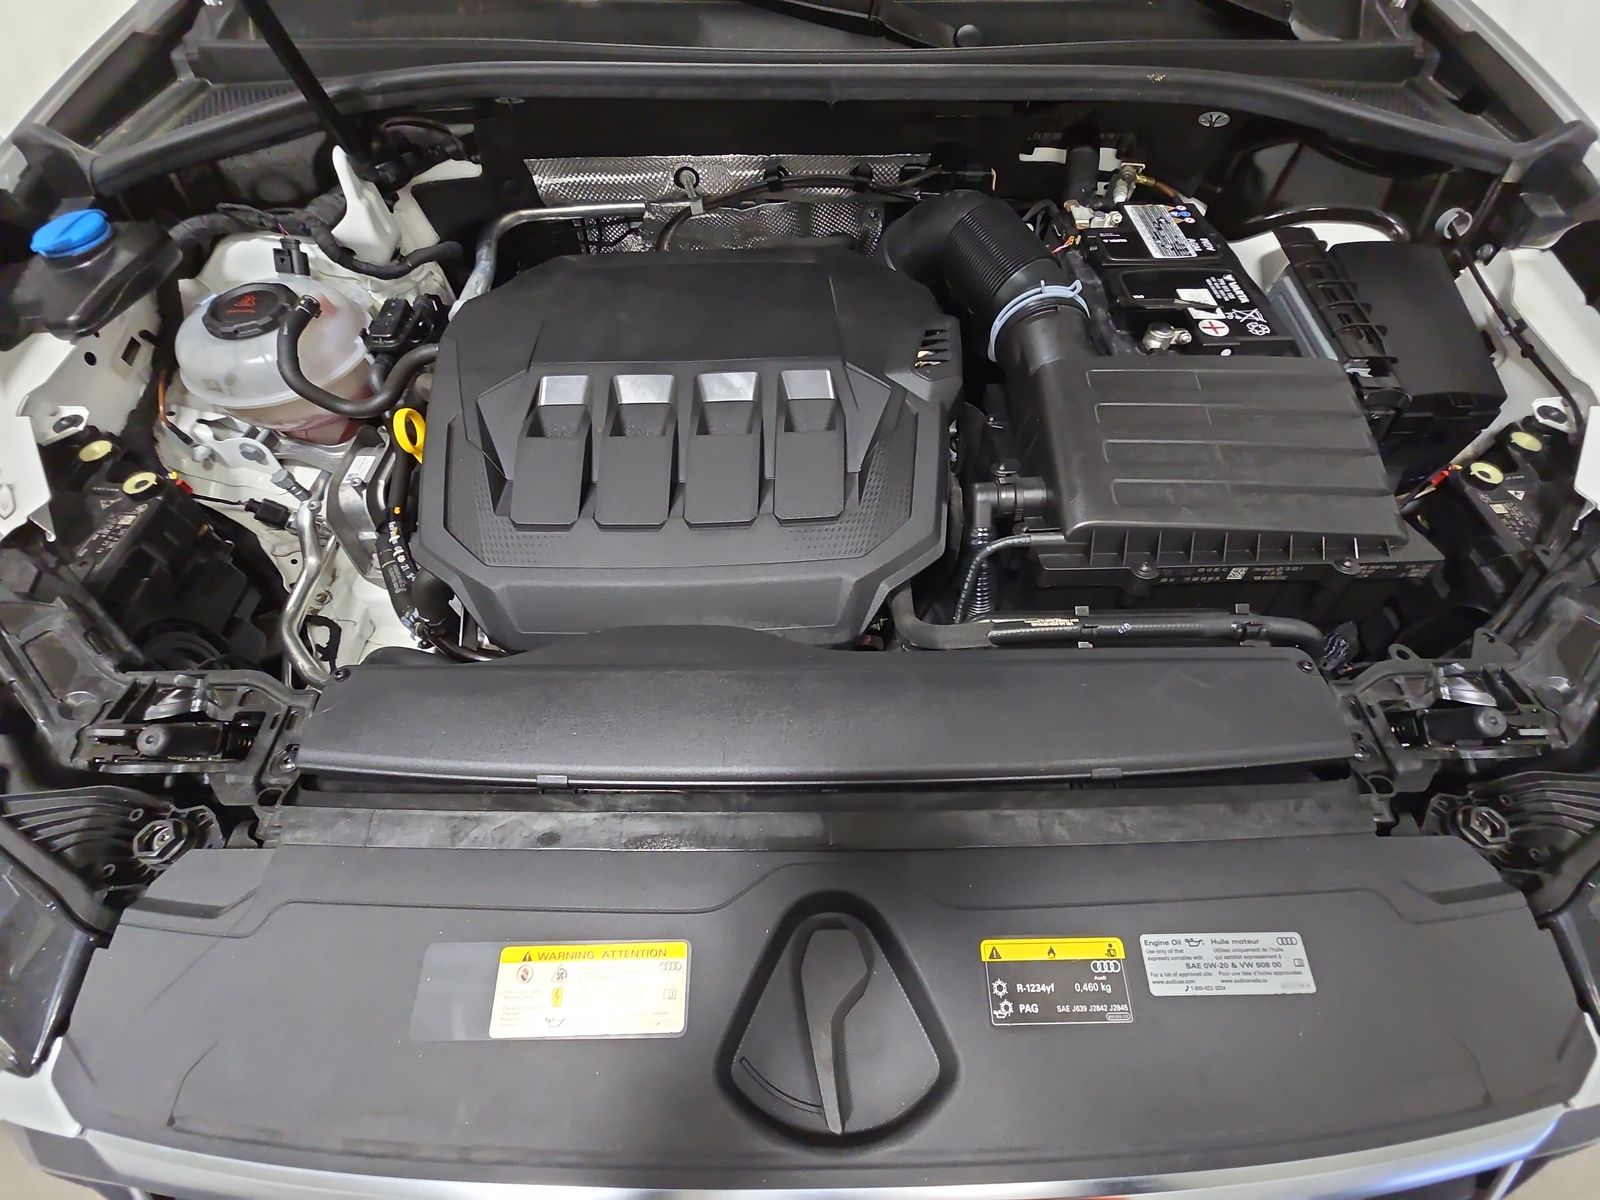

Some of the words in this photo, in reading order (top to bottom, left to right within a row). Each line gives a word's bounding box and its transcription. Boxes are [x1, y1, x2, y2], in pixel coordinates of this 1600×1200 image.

[1228, 281, 1250, 304] VARTA
[1144, 939, 1170, 947] Engine
[537, 951, 595, 961] WARNING
[601, 949, 667, 959] ATTENTION
[1016, 982, 1055, 995] R-1234yf
[1074, 982, 1099, 993] 0,460
[1100, 982, 1112, 994] kg
[1019, 1003, 1039, 1014] PAG
[1109, 1004, 1129, 1012] J2845
